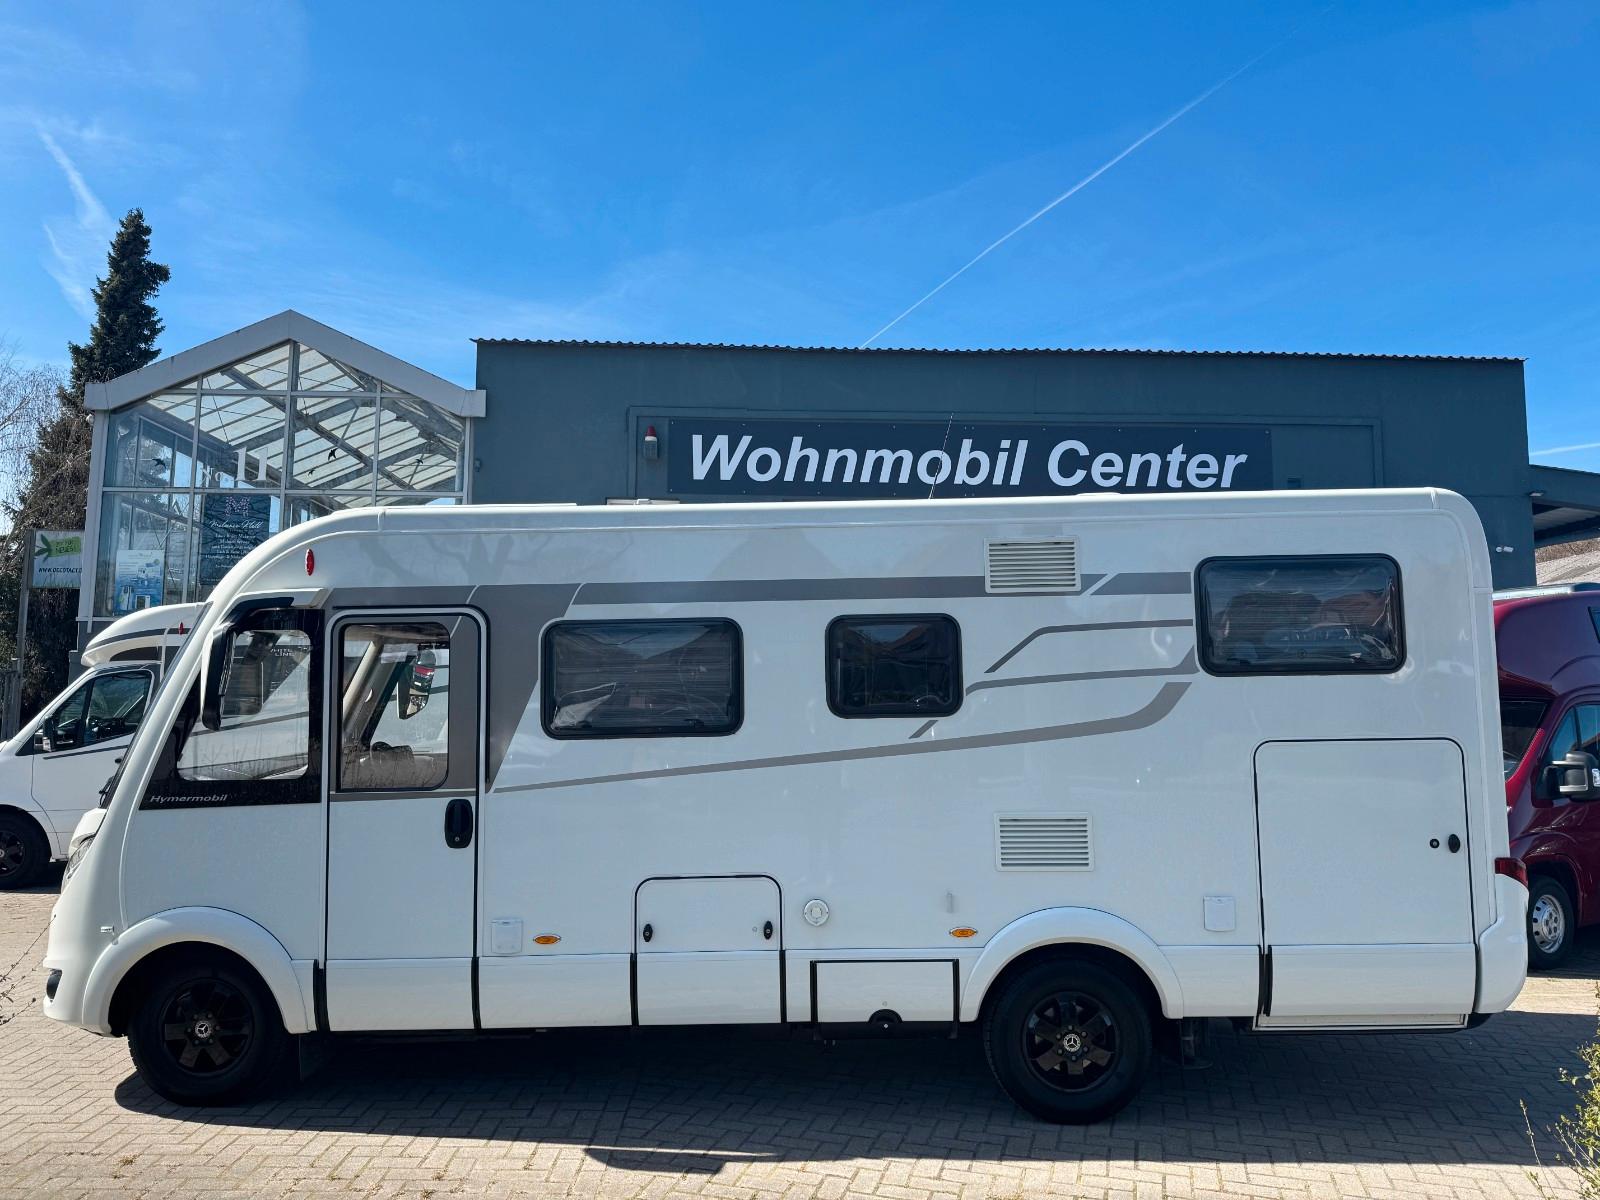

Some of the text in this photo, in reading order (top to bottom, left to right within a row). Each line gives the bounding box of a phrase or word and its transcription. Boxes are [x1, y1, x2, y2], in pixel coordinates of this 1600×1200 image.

[691, 433, 1248, 489] Wohnmobil Center
[150, 794, 228, 804] Hymermobil
